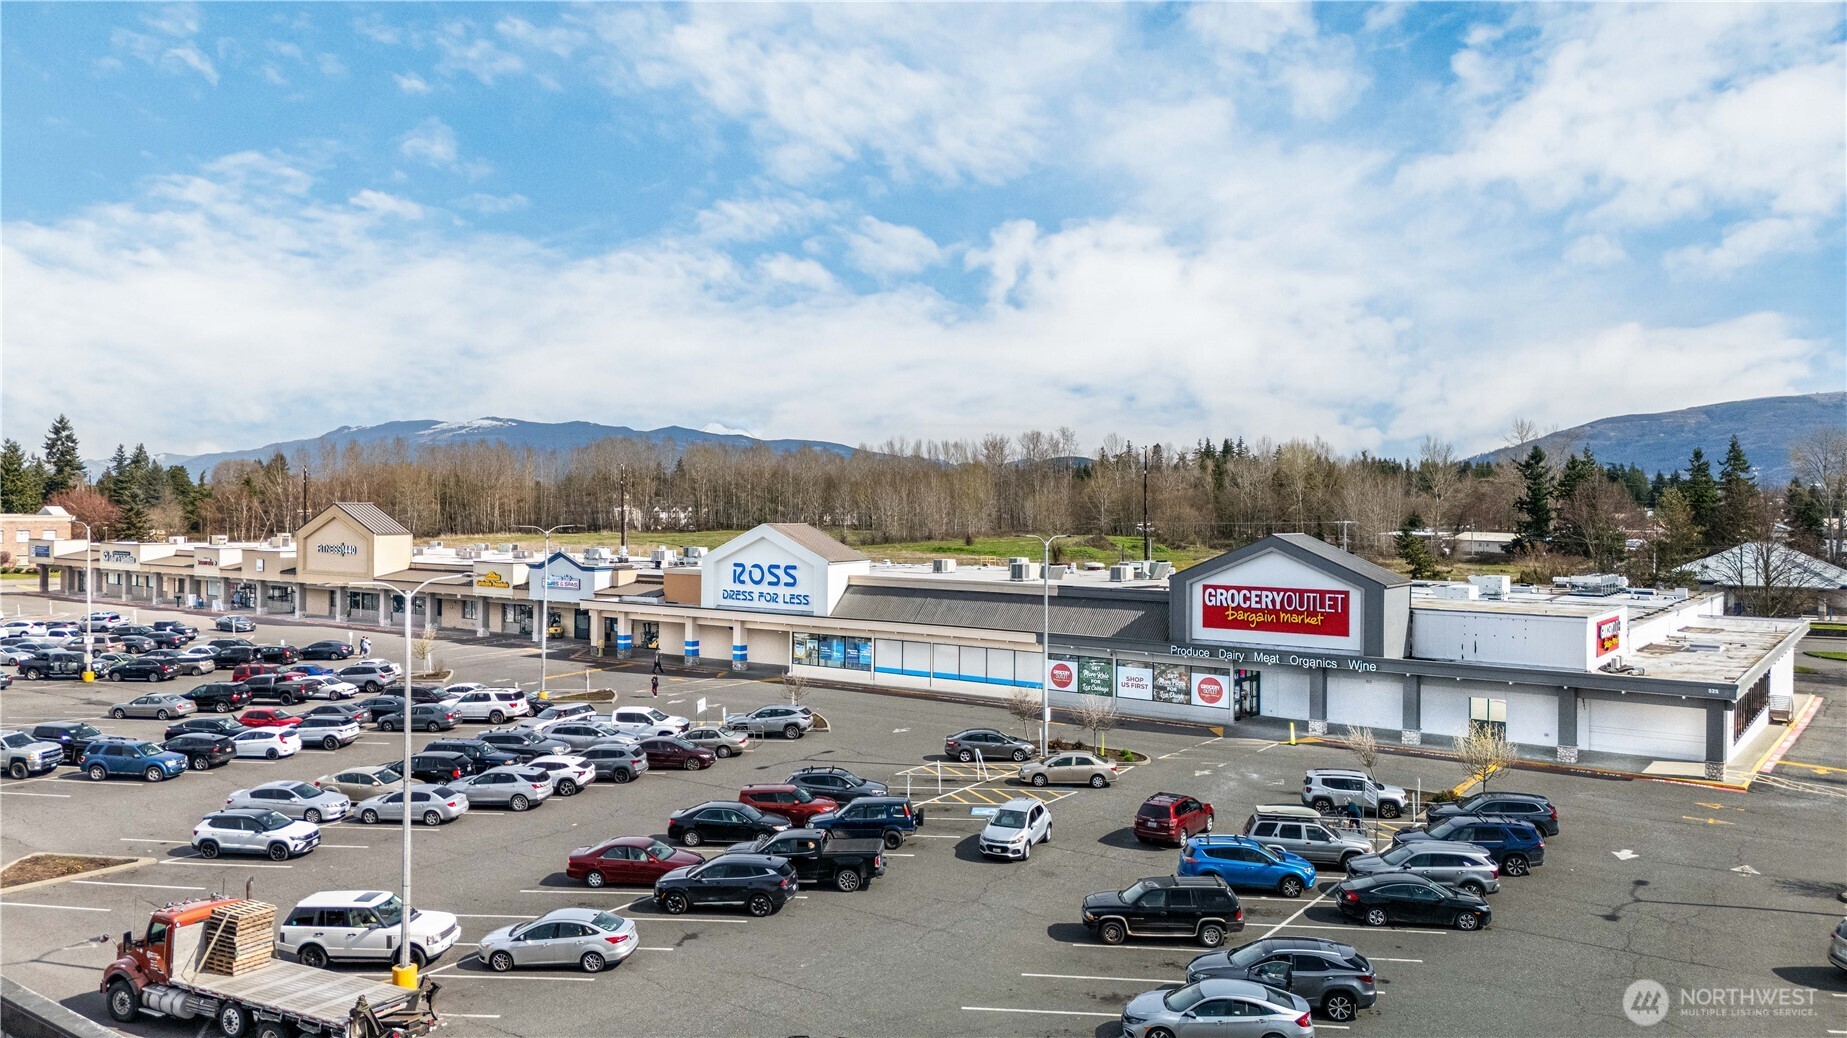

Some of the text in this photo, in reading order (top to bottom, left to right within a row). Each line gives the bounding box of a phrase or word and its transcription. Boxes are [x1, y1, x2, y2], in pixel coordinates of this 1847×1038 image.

[733, 562, 797, 587] ROSS
[722, 589, 810, 605] DRESS FOR LESS
[1225, 604, 1324, 627] bargain market
[1170, 645, 1377, 672] Produce Dairy Meat Organics Wine
[1125, 675, 1144, 683] SHOP
[1131, 682, 1149, 690] FIRST
